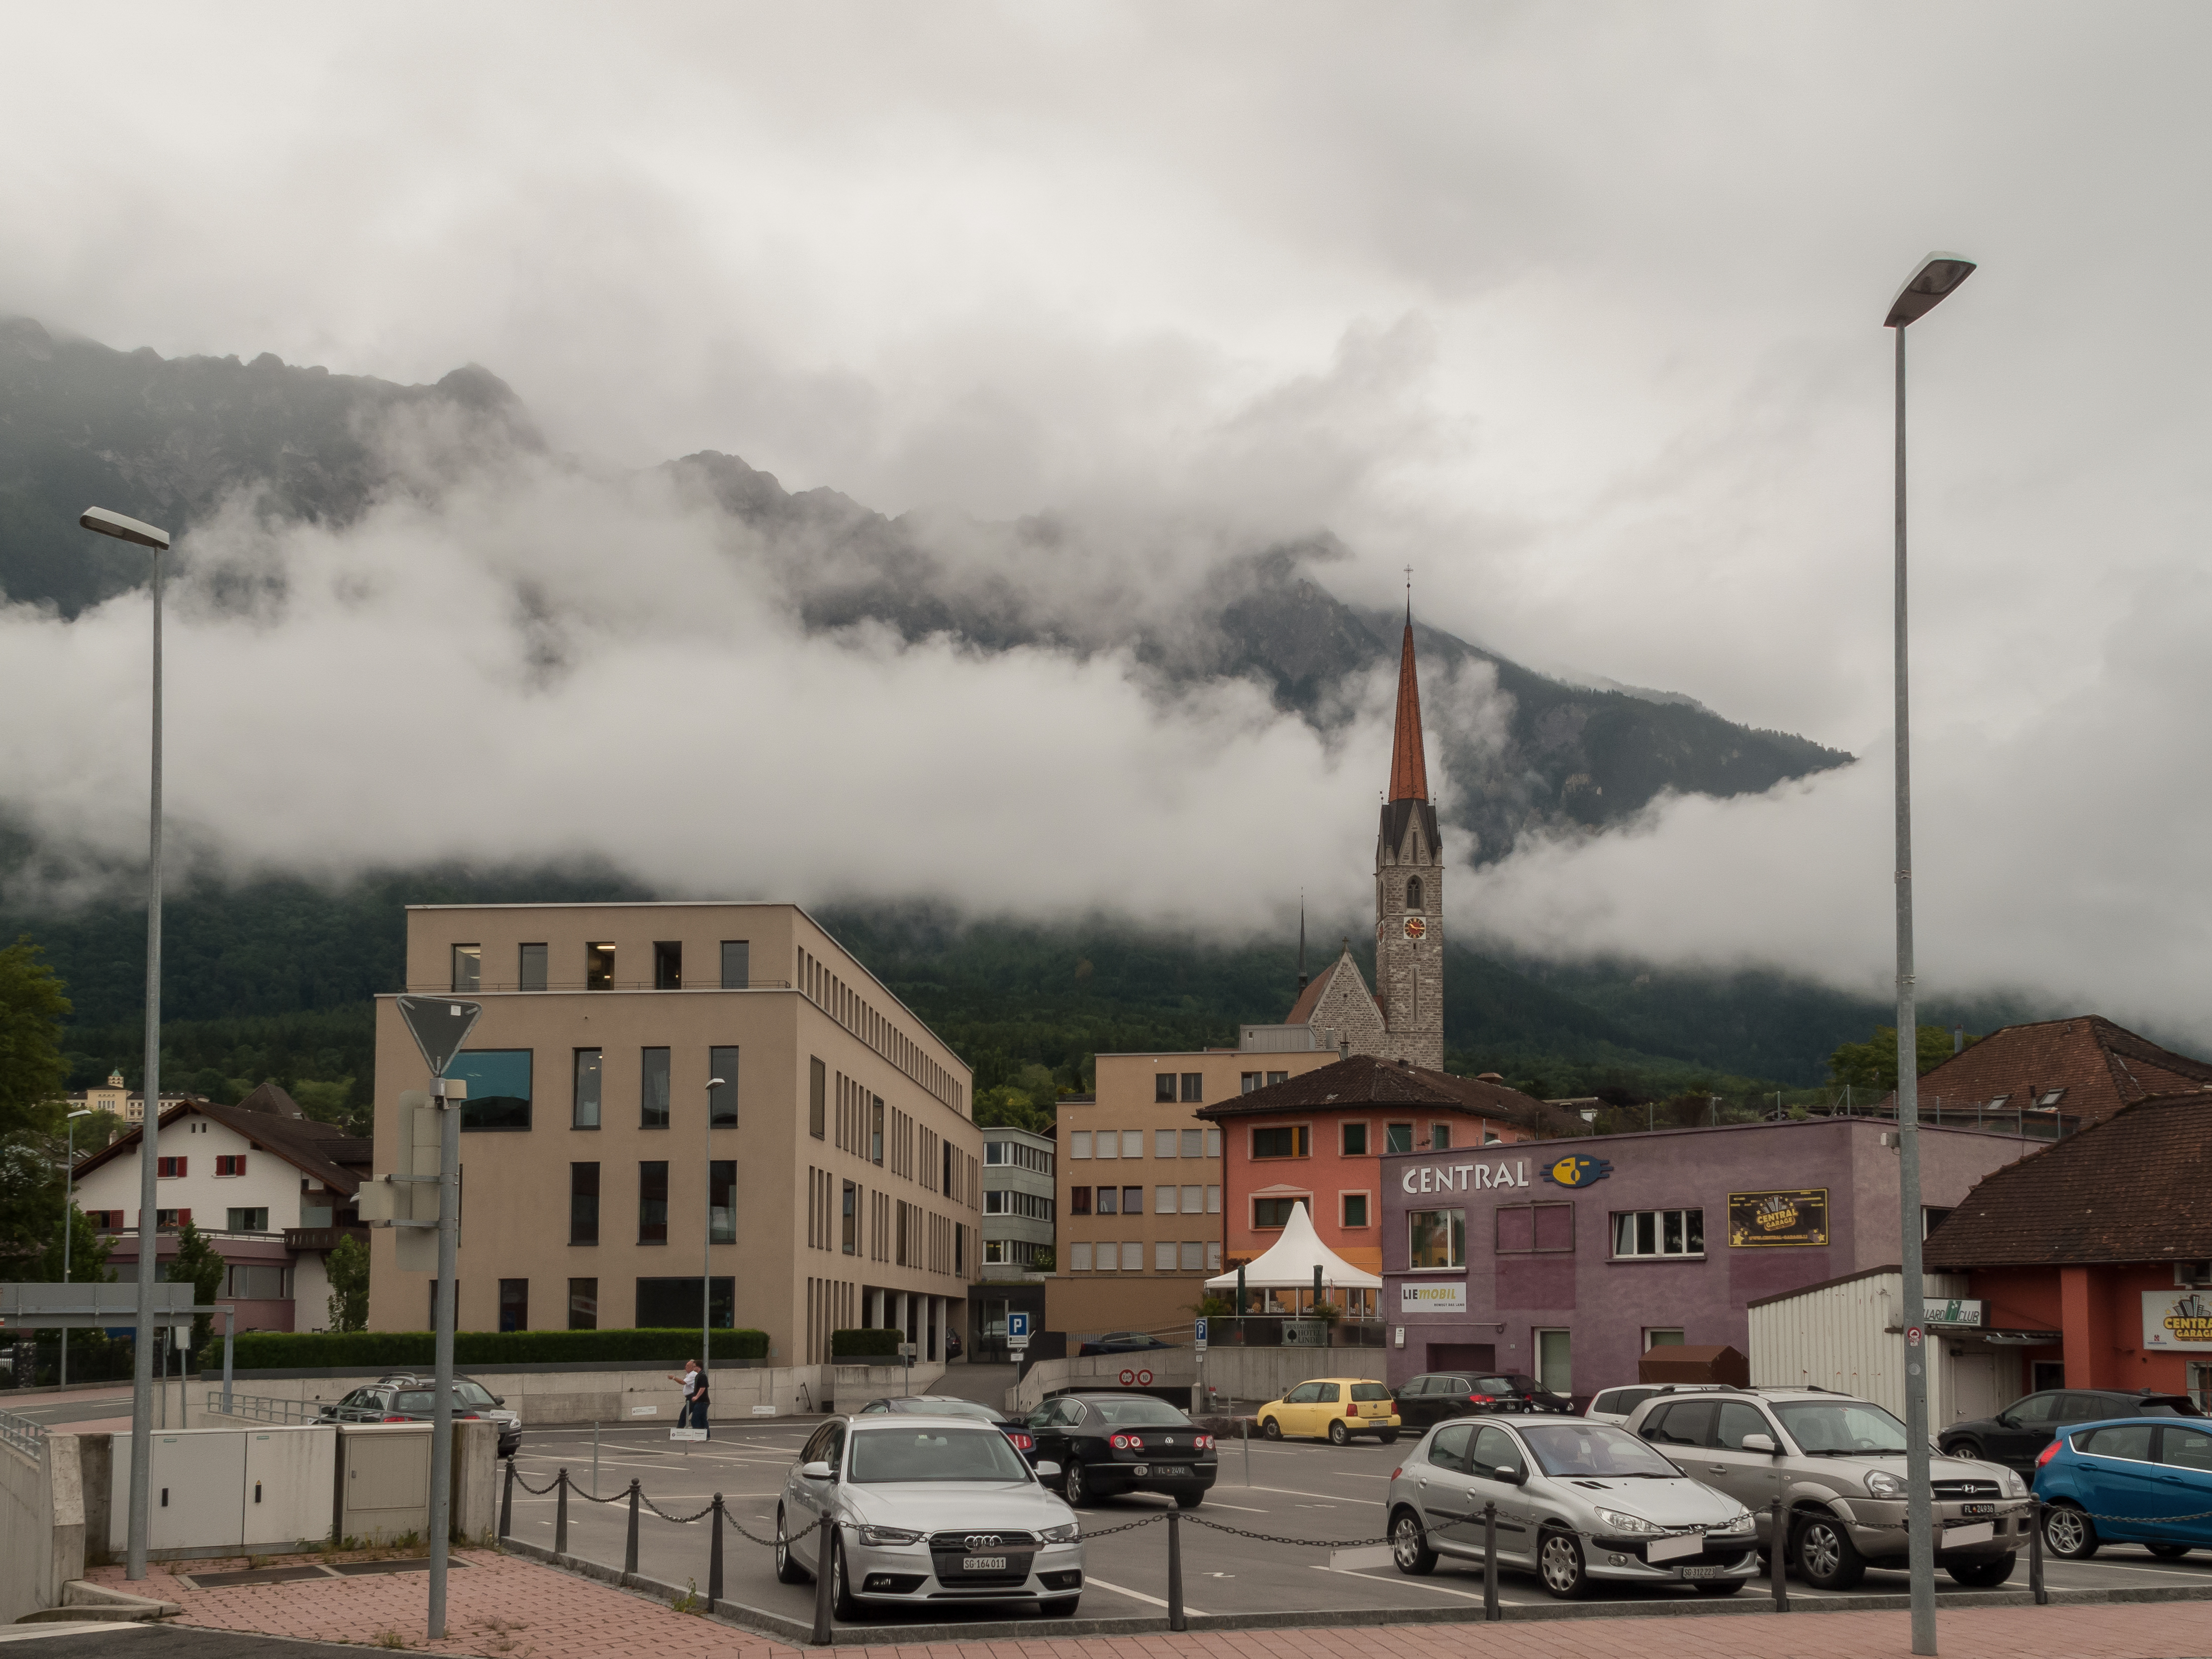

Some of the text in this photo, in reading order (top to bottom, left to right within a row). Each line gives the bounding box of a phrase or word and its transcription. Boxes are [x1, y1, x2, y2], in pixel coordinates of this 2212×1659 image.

[1402, 1161, 1529, 1194] CENTRAL
[1757, 1208, 1798, 1224] CENTRAL
[1766, 1217, 1793, 1228] GARAGE
[1958, 1310, 1980, 1322] CLUB
[1014, 1318, 1022, 1333] P
[1198, 1325, 1203, 1338] P
[2176, 1329, 2212, 1337] GARAG
